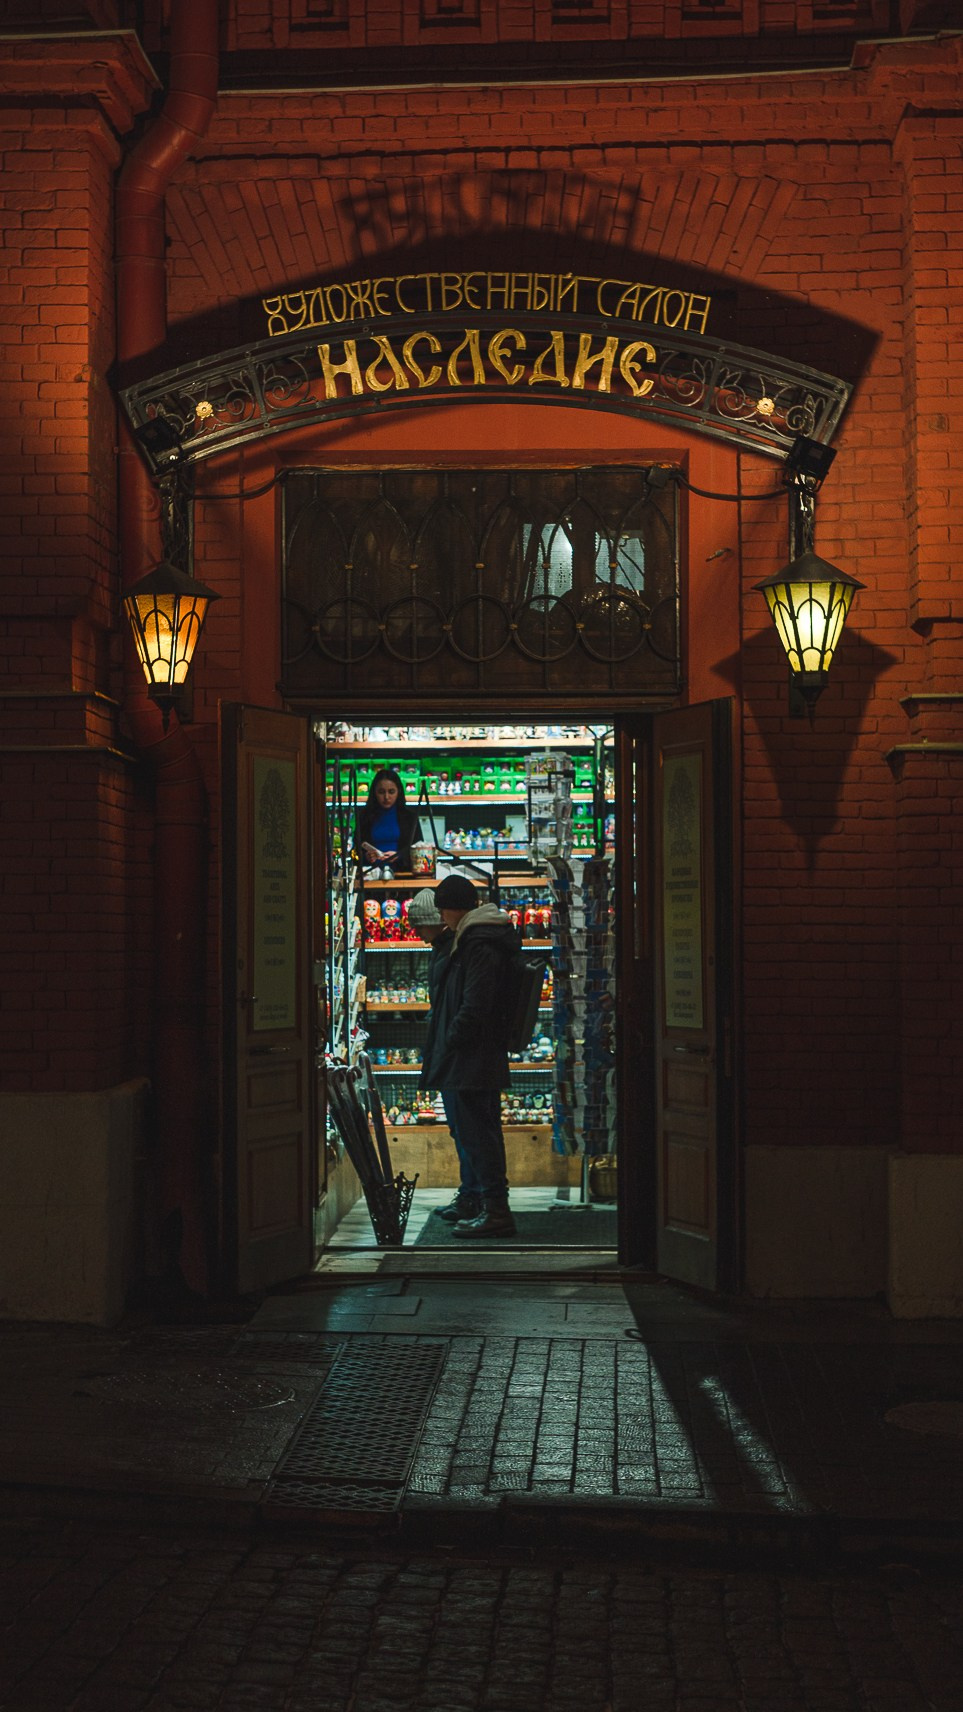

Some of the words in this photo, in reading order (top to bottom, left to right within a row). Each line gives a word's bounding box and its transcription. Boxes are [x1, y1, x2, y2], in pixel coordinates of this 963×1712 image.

[262, 271, 578, 337] ХУДОЖЕСТВЕННЫЙ
[597, 278, 712, 335] САЛОН
[317, 328, 657, 399] НАСЛЕДИЕ
